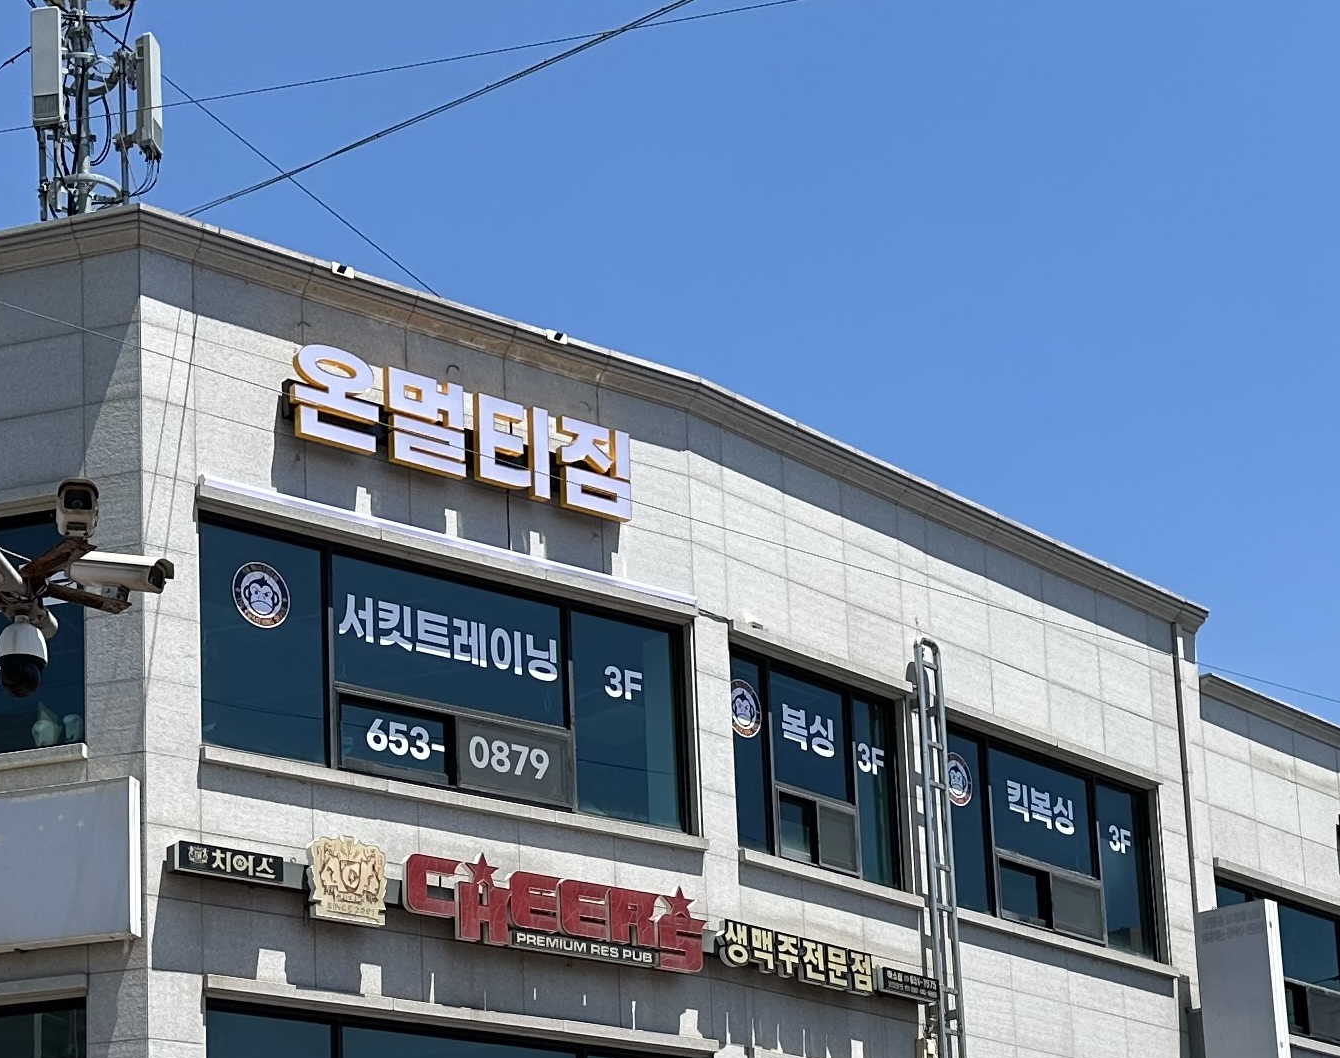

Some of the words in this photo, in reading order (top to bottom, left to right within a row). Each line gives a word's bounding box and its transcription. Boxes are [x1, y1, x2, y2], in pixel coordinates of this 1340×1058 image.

[290, 344, 631, 522] 온멀티짐
[338, 594, 559, 683] 서킷트레이닝
[603, 665, 643, 701] 3F
[781, 704, 835, 759] 복싱
[857, 743, 884, 775] 3F
[1005, 779, 1075, 836] 킥복싱
[1107, 824, 1131, 855] 3F
[211, 849, 276, 879] 치어스
[403, 852, 707, 973] CHEERS
[515, 932, 587, 957] PREMIUM
[590, 942, 619, 959] RES
[622, 946, 655, 965] PUB
[725, 921, 873, 993] 생맥주전문점
